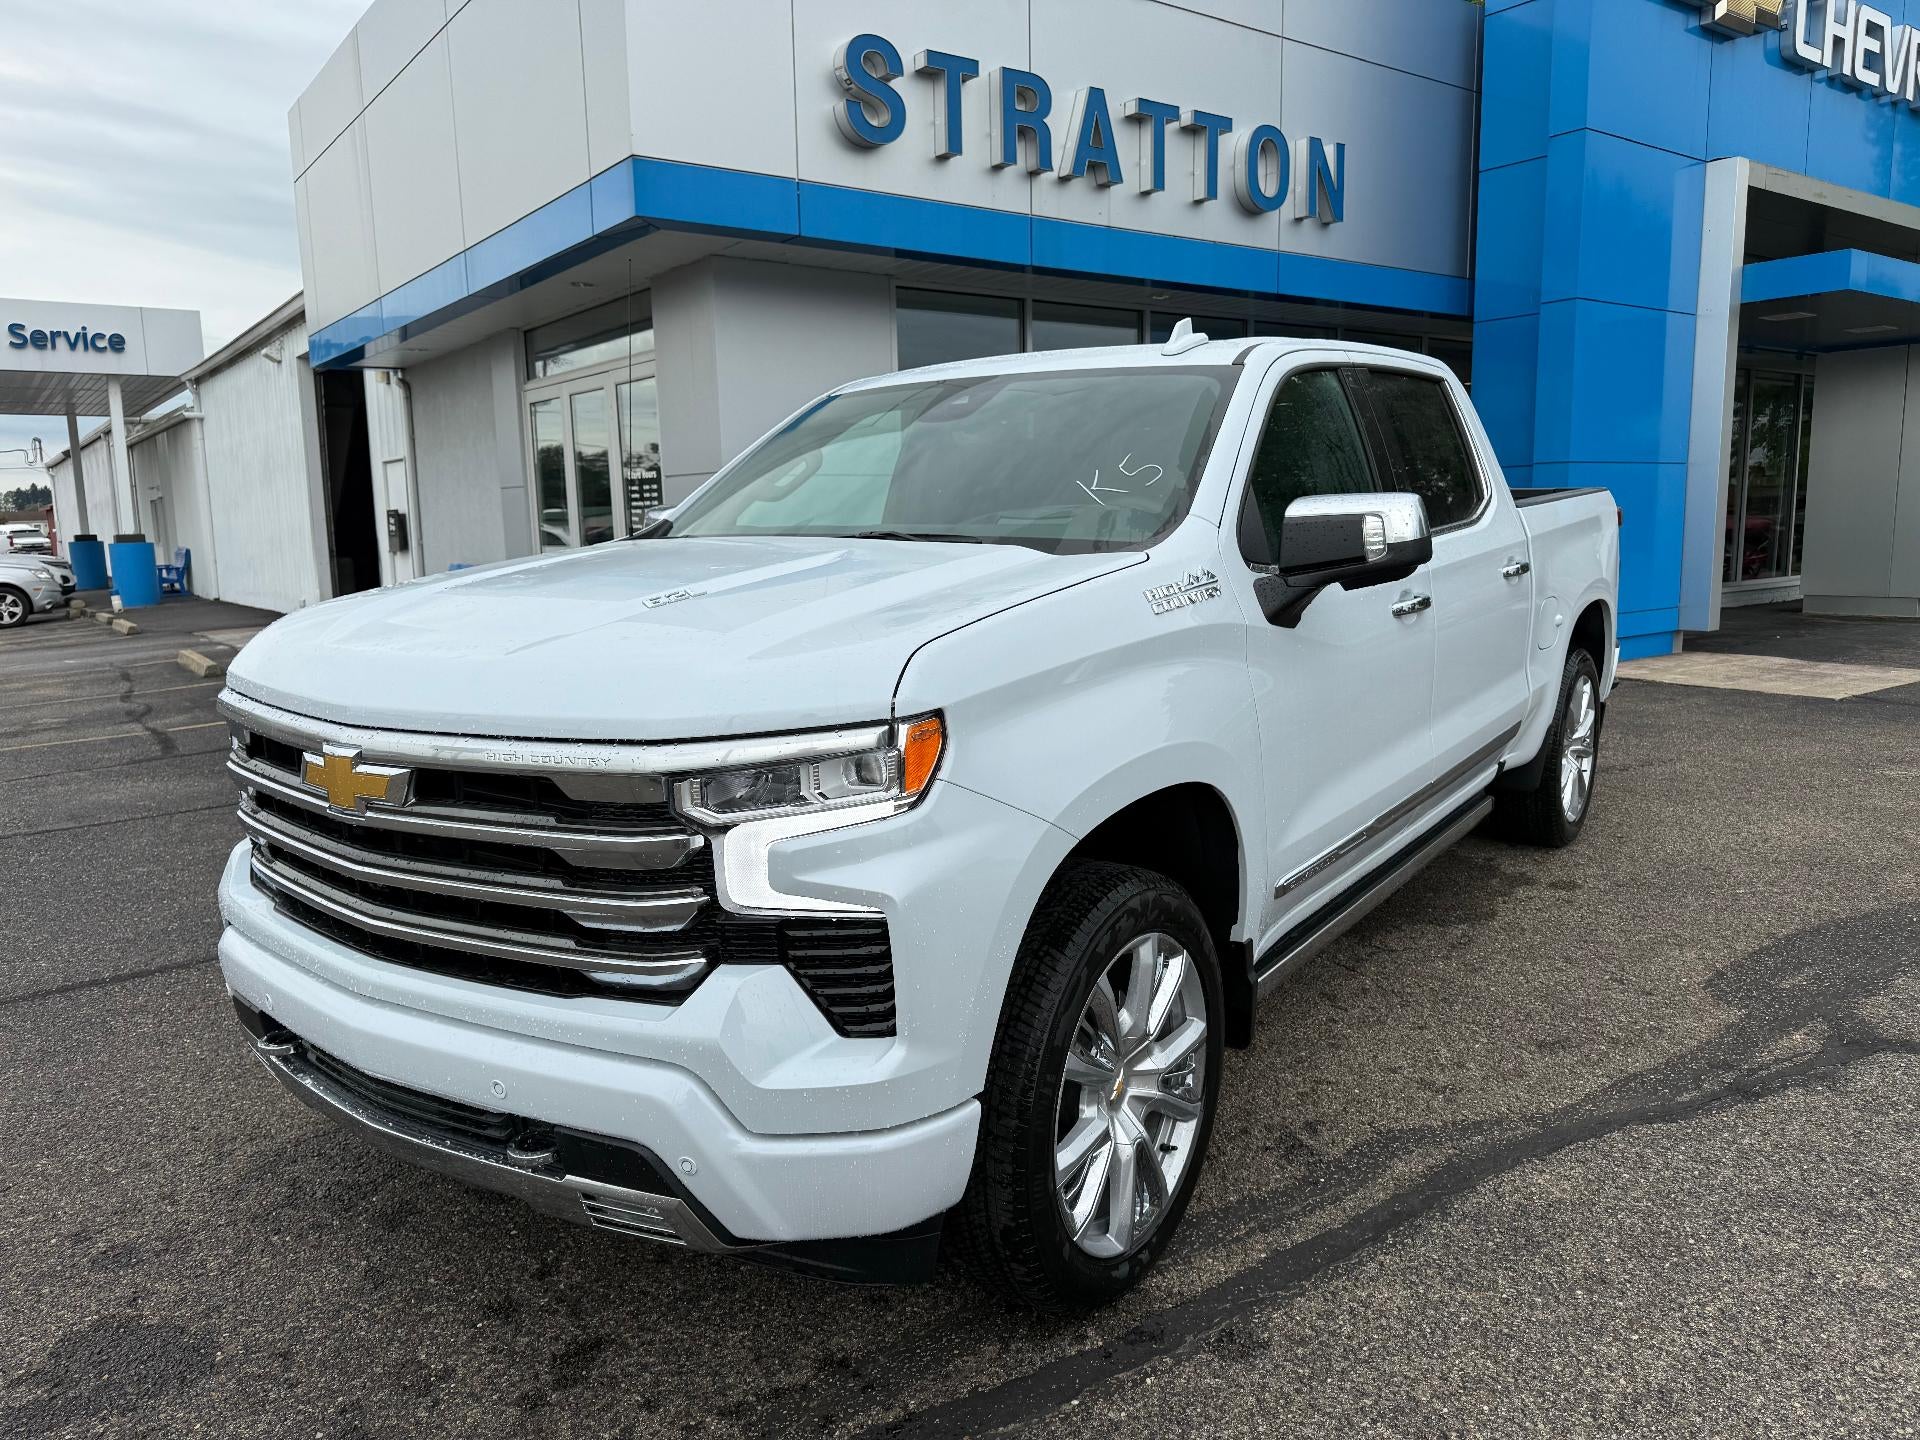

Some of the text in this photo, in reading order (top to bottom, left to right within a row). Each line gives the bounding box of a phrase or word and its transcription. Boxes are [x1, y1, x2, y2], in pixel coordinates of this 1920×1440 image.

[833, 33, 1345, 226] STRATTON
[7, 322, 126, 353] Service
[1143, 582, 1185, 602] HIGH
[1151, 584, 1222, 615] COUNTRY
[485, 752, 611, 767] HIGH COUNTRY
